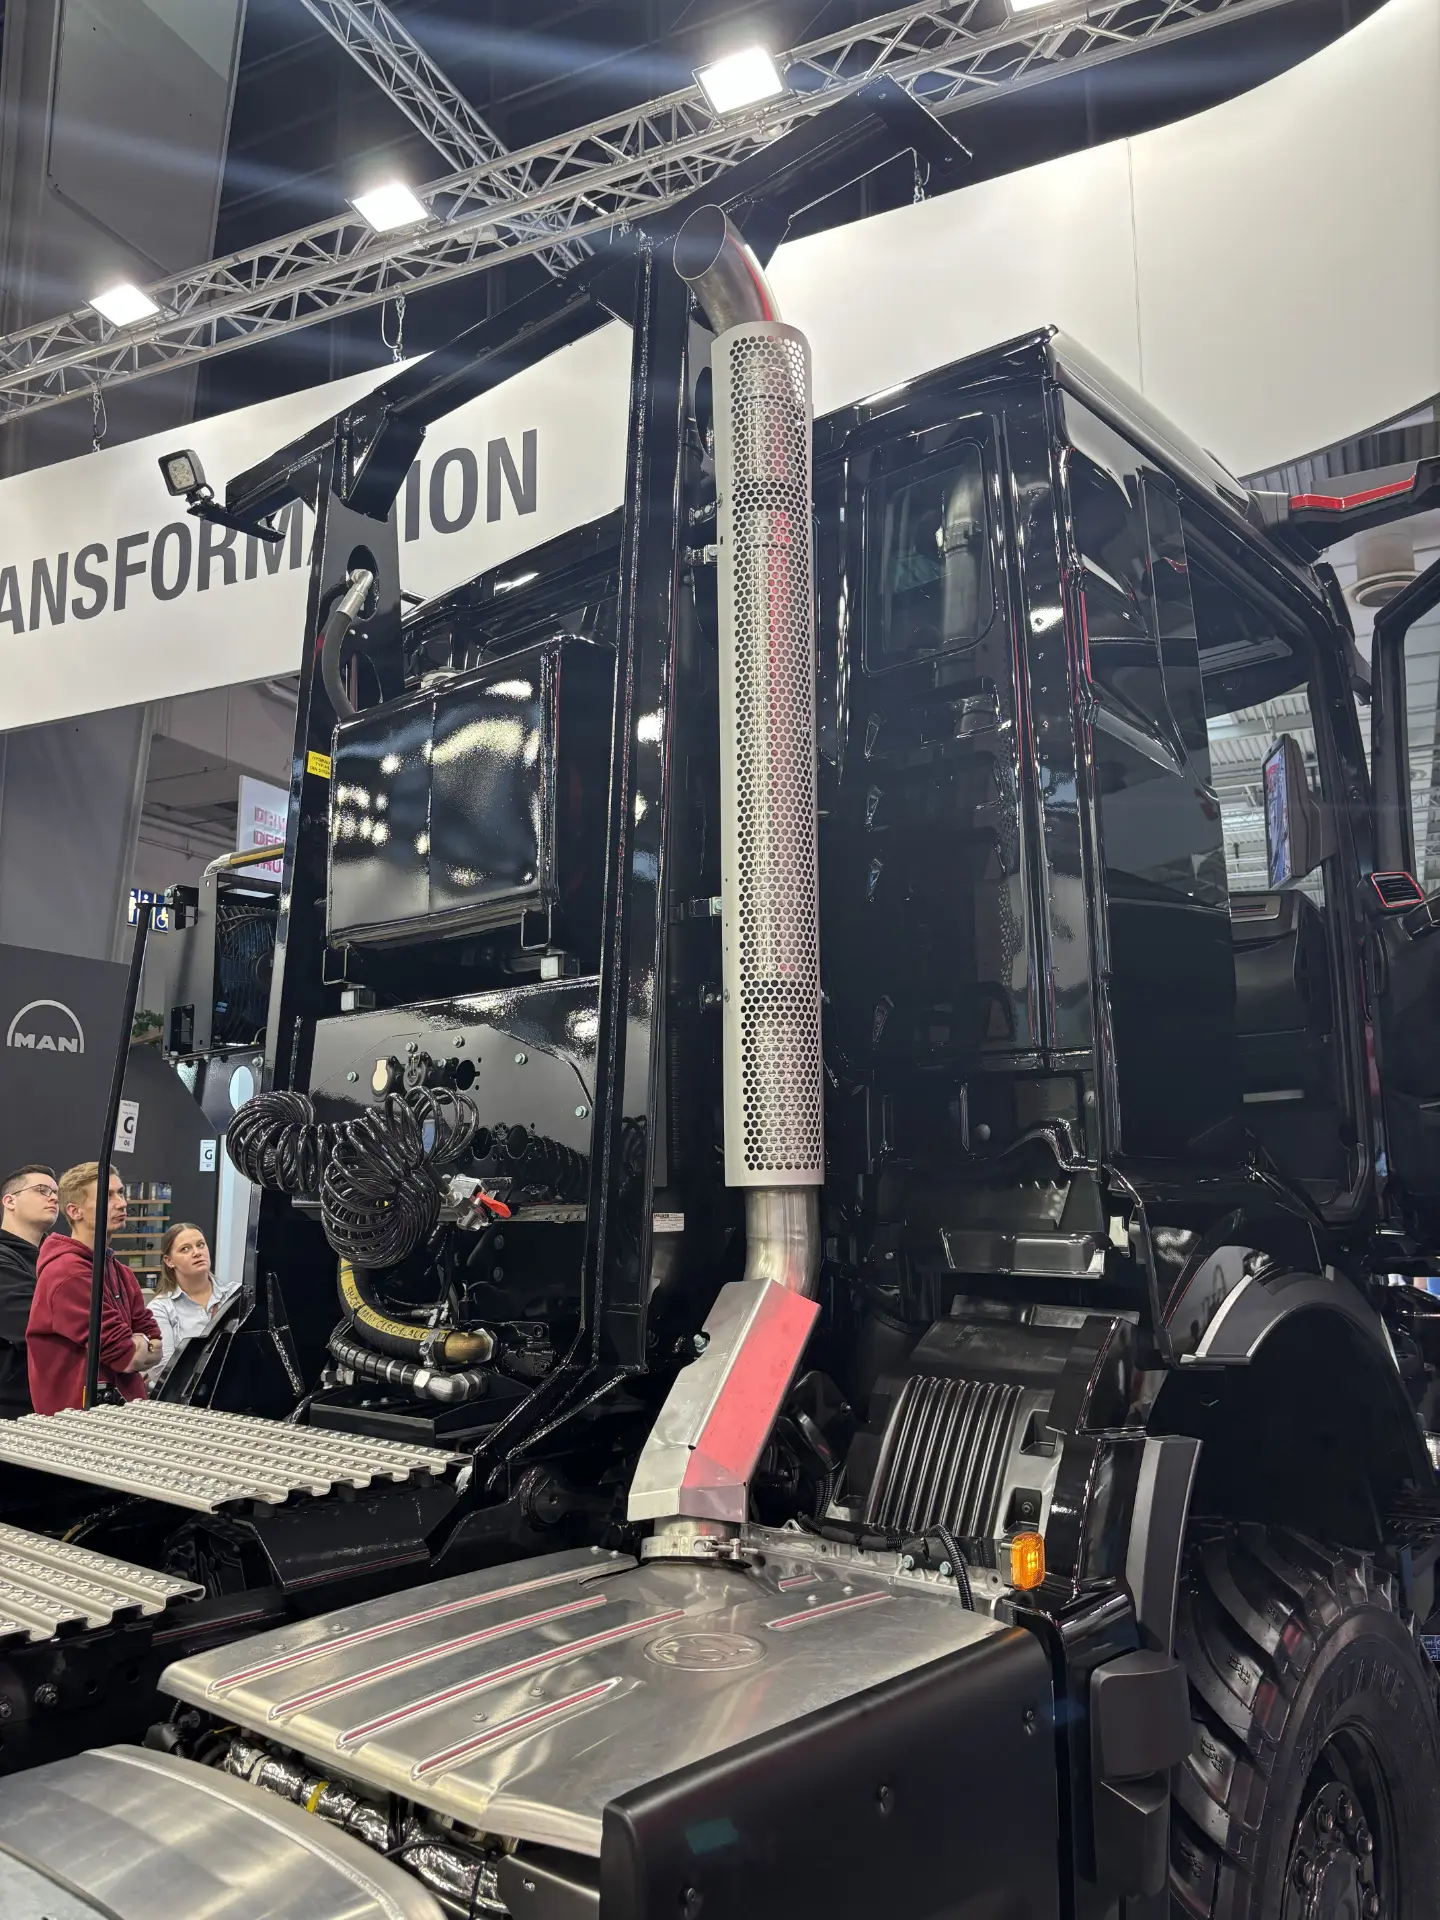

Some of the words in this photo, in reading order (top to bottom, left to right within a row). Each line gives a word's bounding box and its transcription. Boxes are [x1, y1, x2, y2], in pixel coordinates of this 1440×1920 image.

[14, 1032, 78, 1053] MAN
[123, 1116, 134, 1134] G
[205, 1149, 212, 1160] G
